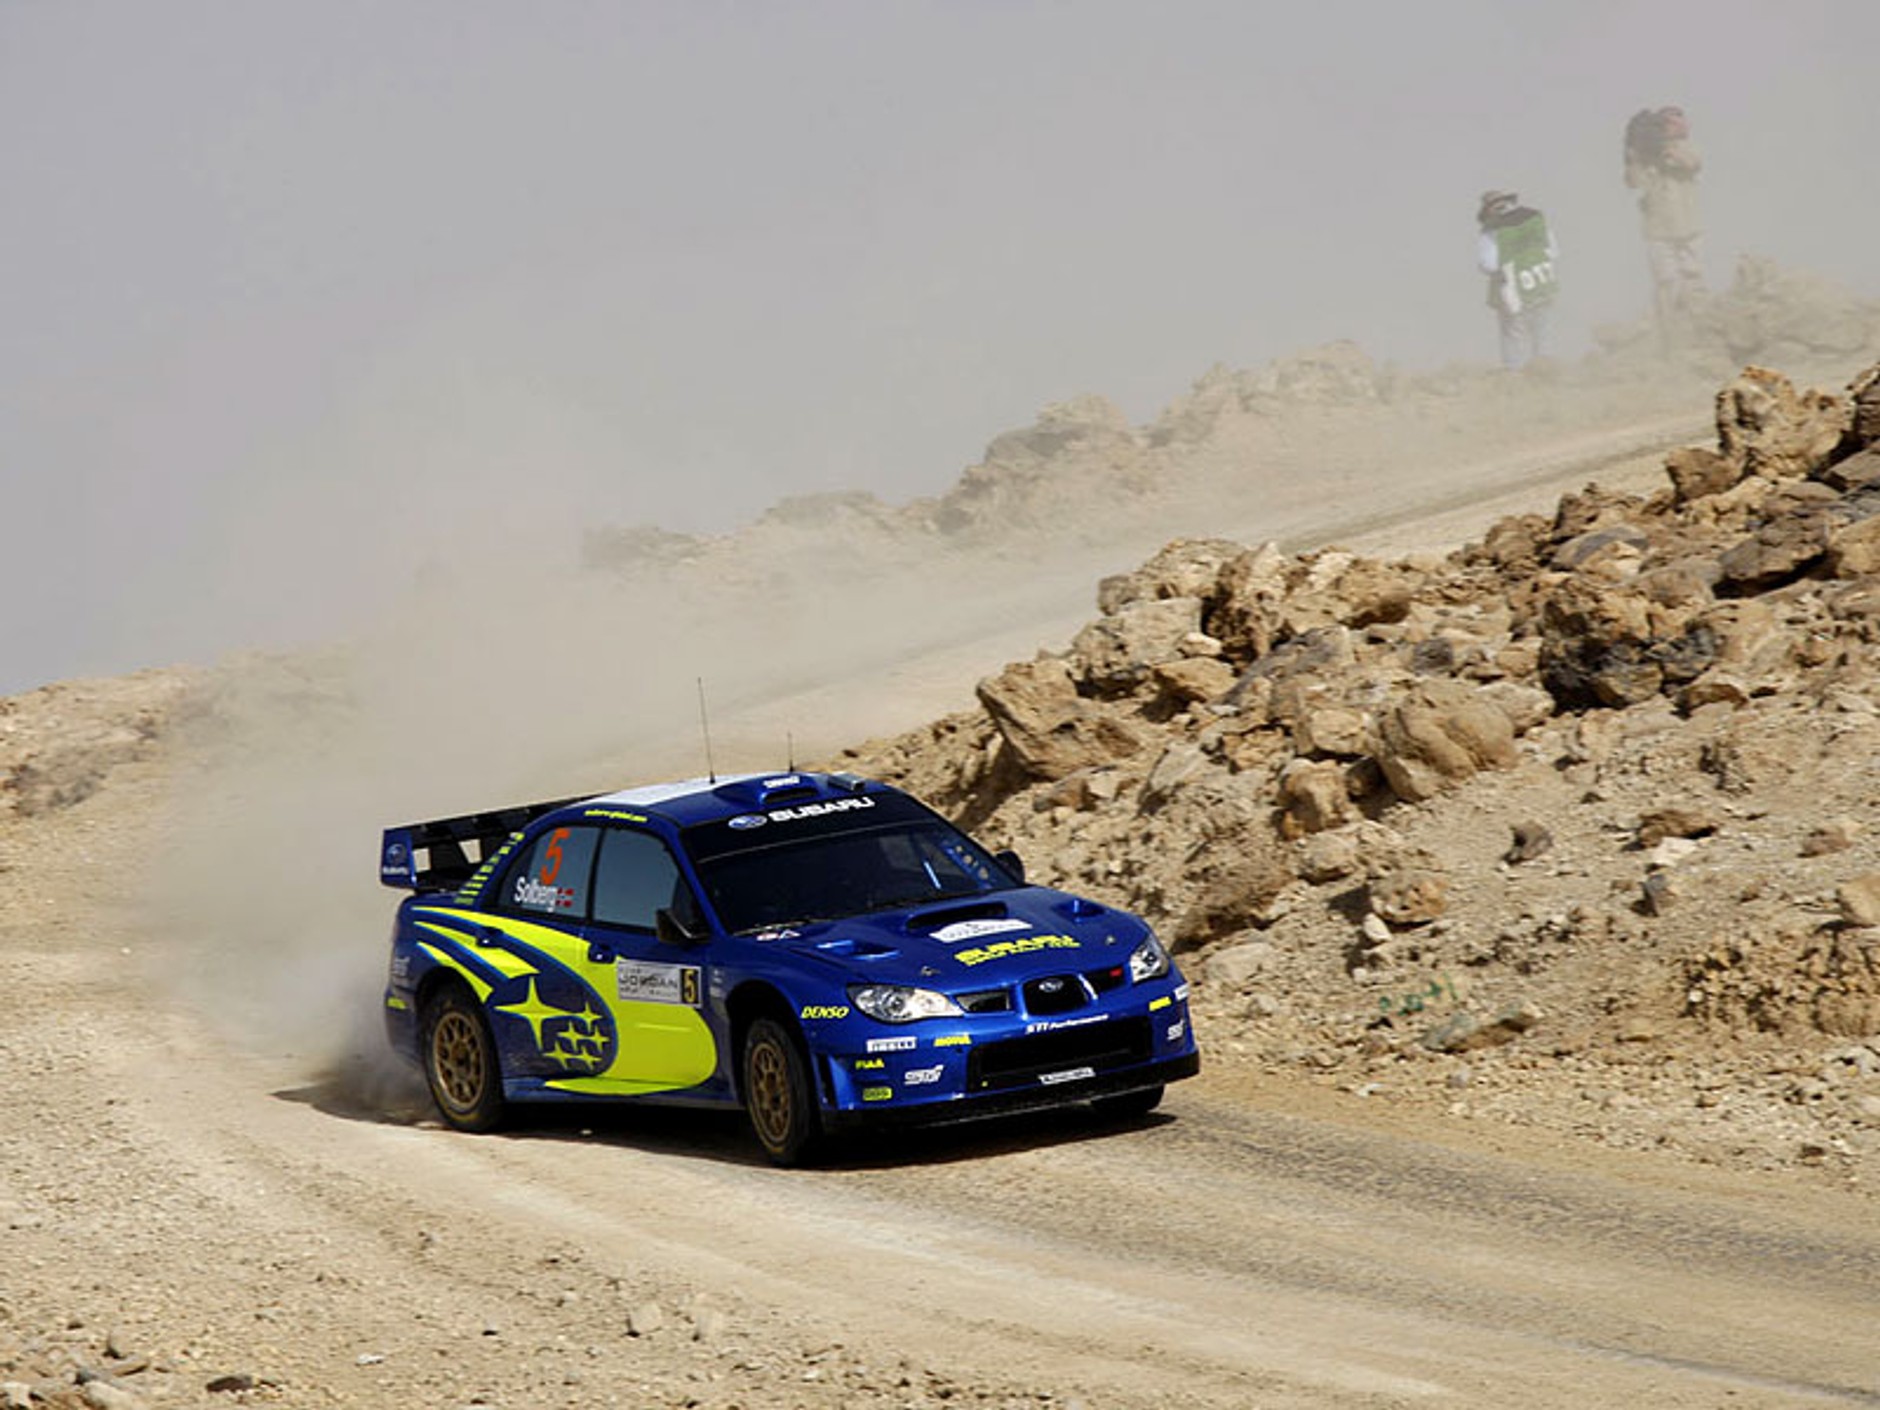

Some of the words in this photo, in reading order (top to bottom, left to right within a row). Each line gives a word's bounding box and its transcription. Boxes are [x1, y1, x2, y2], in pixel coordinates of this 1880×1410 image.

[769, 796, 875, 822] SUBARU
[540, 828, 570, 885] 5
[515, 876, 558, 912] Solberg
[684, 969, 696, 1003] 5
[801, 1006, 849, 1019] DENSO
